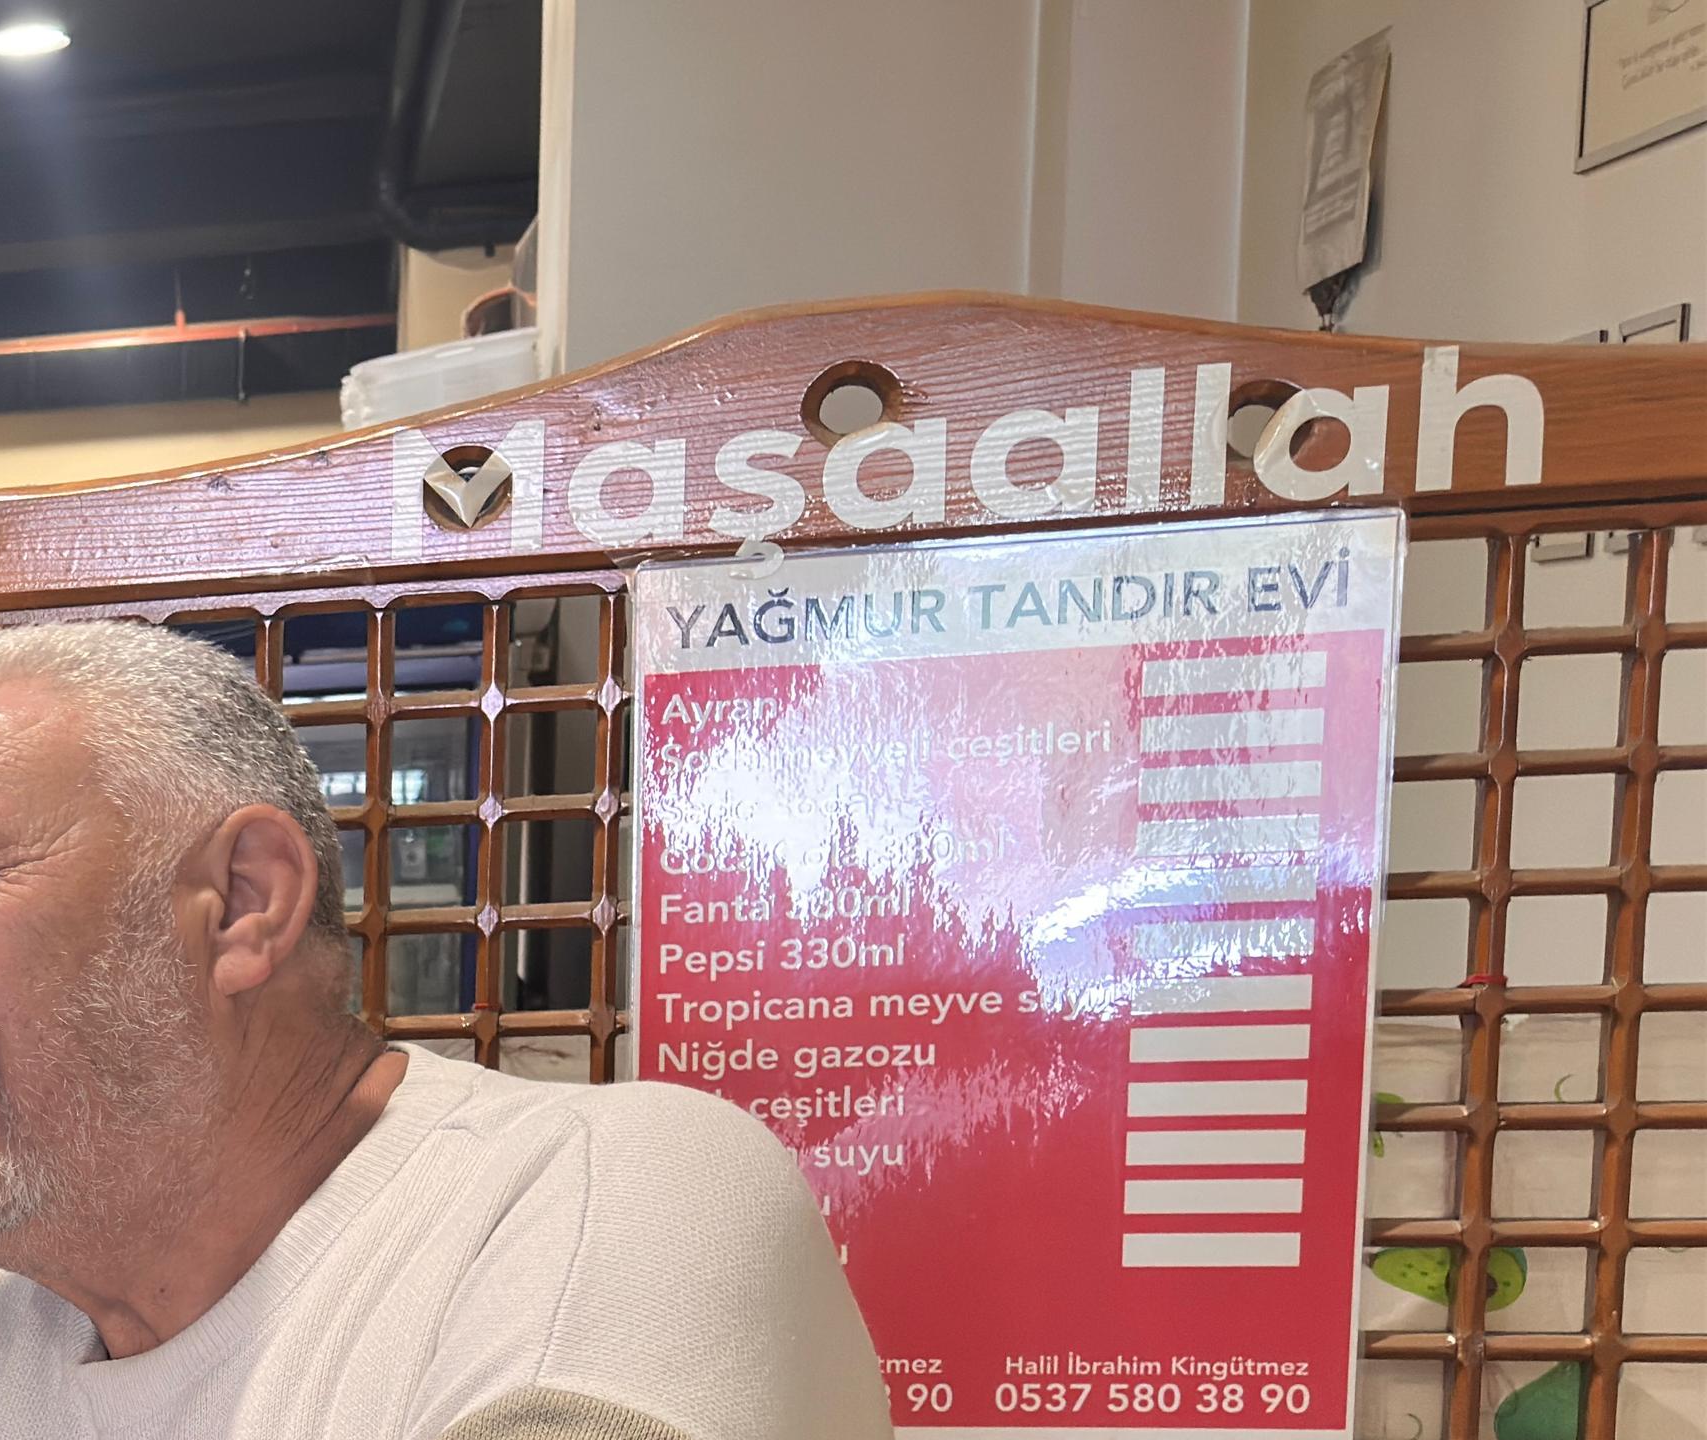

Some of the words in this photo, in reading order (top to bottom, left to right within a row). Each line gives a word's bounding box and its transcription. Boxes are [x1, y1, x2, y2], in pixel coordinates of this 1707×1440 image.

[666, 587, 947, 650] YAĞMUR
[968, 569, 1220, 630] TANDIR
[1247, 547, 1350, 613] EVİ
[660, 693, 779, 733] Ayran
[660, 893, 770, 925] Fanta
[659, 940, 766, 982] Pepsi
[780, 933, 905, 970] 330ml
[656, 990, 853, 1031] Tropicana
[869, 990, 1003, 1025] meyve
[658, 1038, 779, 1080] Niğde
[794, 1043, 936, 1078] gazozu
[813, 1144, 904, 1176] suyu
[878, 1355, 943, 1375] tmez
[1005, 1354, 1059, 1376] Halil
[1067, 1352, 1162, 1377] İbrahim
[1171, 1355, 1310, 1381] Kingütmez
[906, 1382, 954, 1413] 90
[994, 1382, 1092, 1413] 0537
[1106, 1383, 1182, 1413] 580
[1195, 1383, 1245, 1414] 38
[1259, 1383, 1311, 1414] 90
